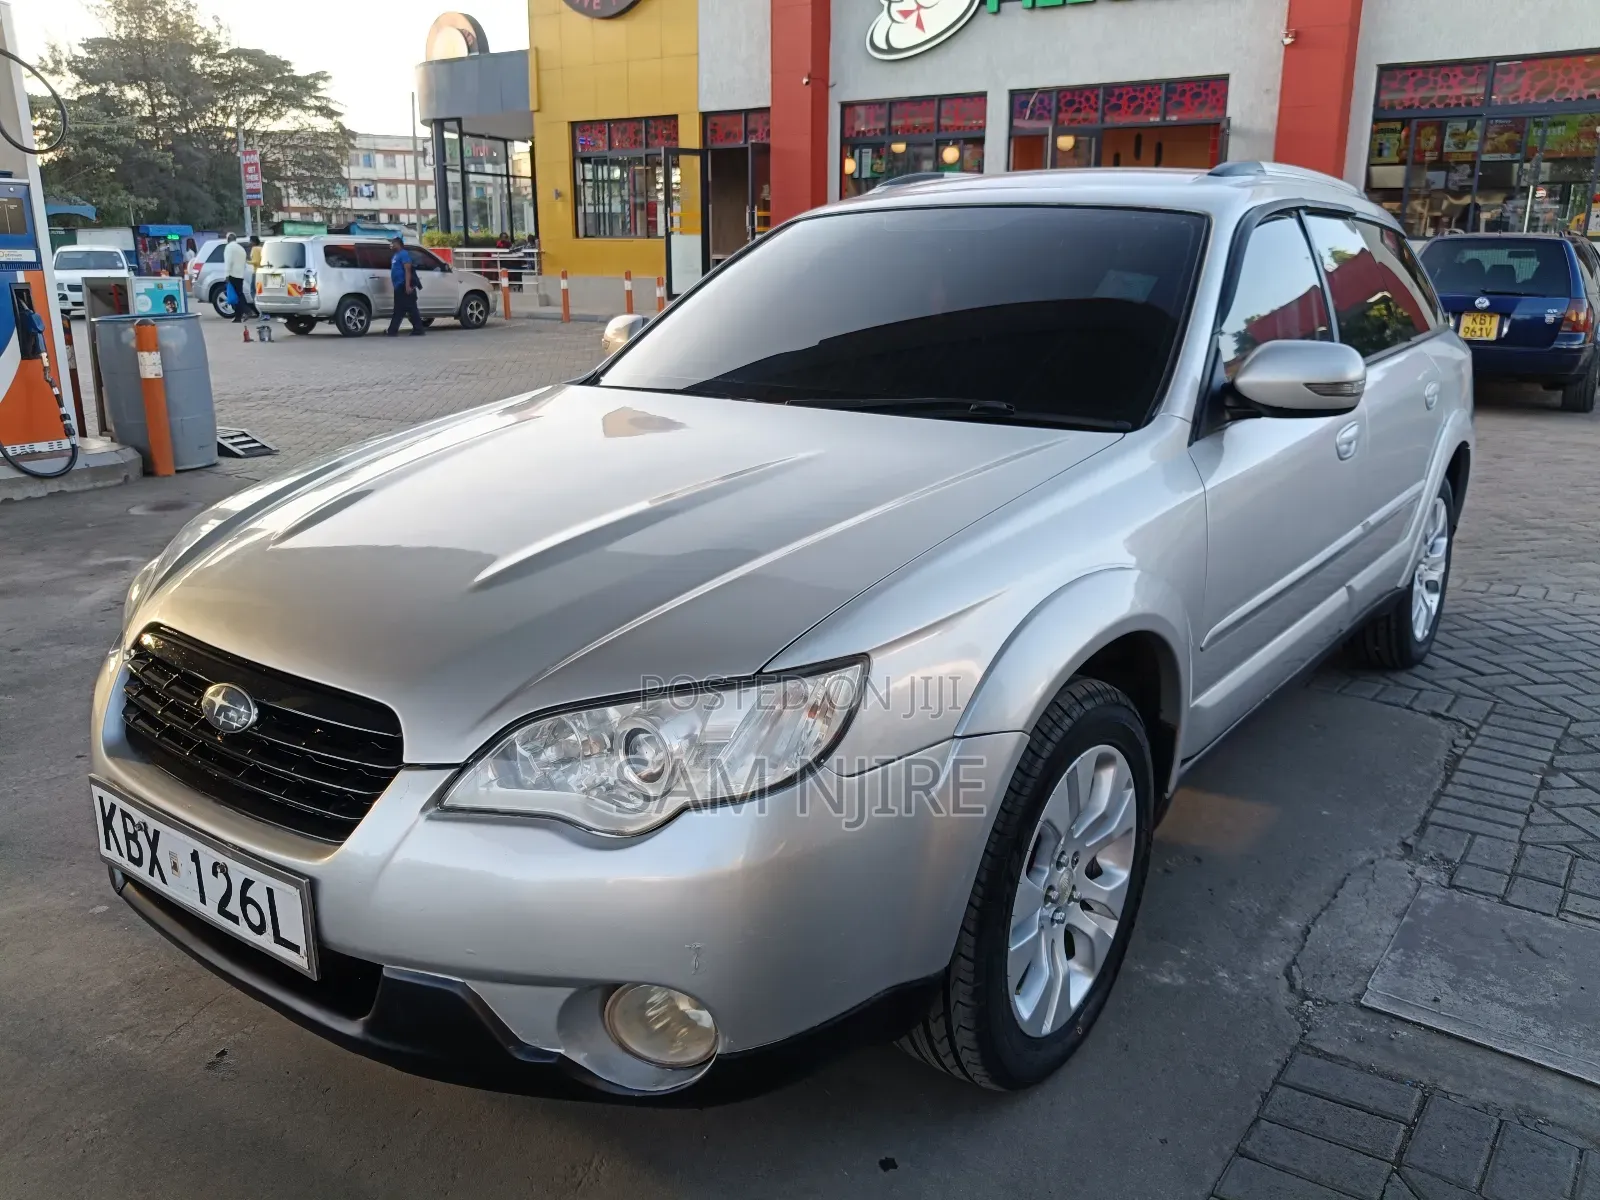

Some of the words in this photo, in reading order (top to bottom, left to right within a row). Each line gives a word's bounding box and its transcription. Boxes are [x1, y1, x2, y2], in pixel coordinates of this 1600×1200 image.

[1463, 326, 1492, 338] 961V
[98, 796, 168, 886] KBX
[190, 848, 301, 956] 126L
